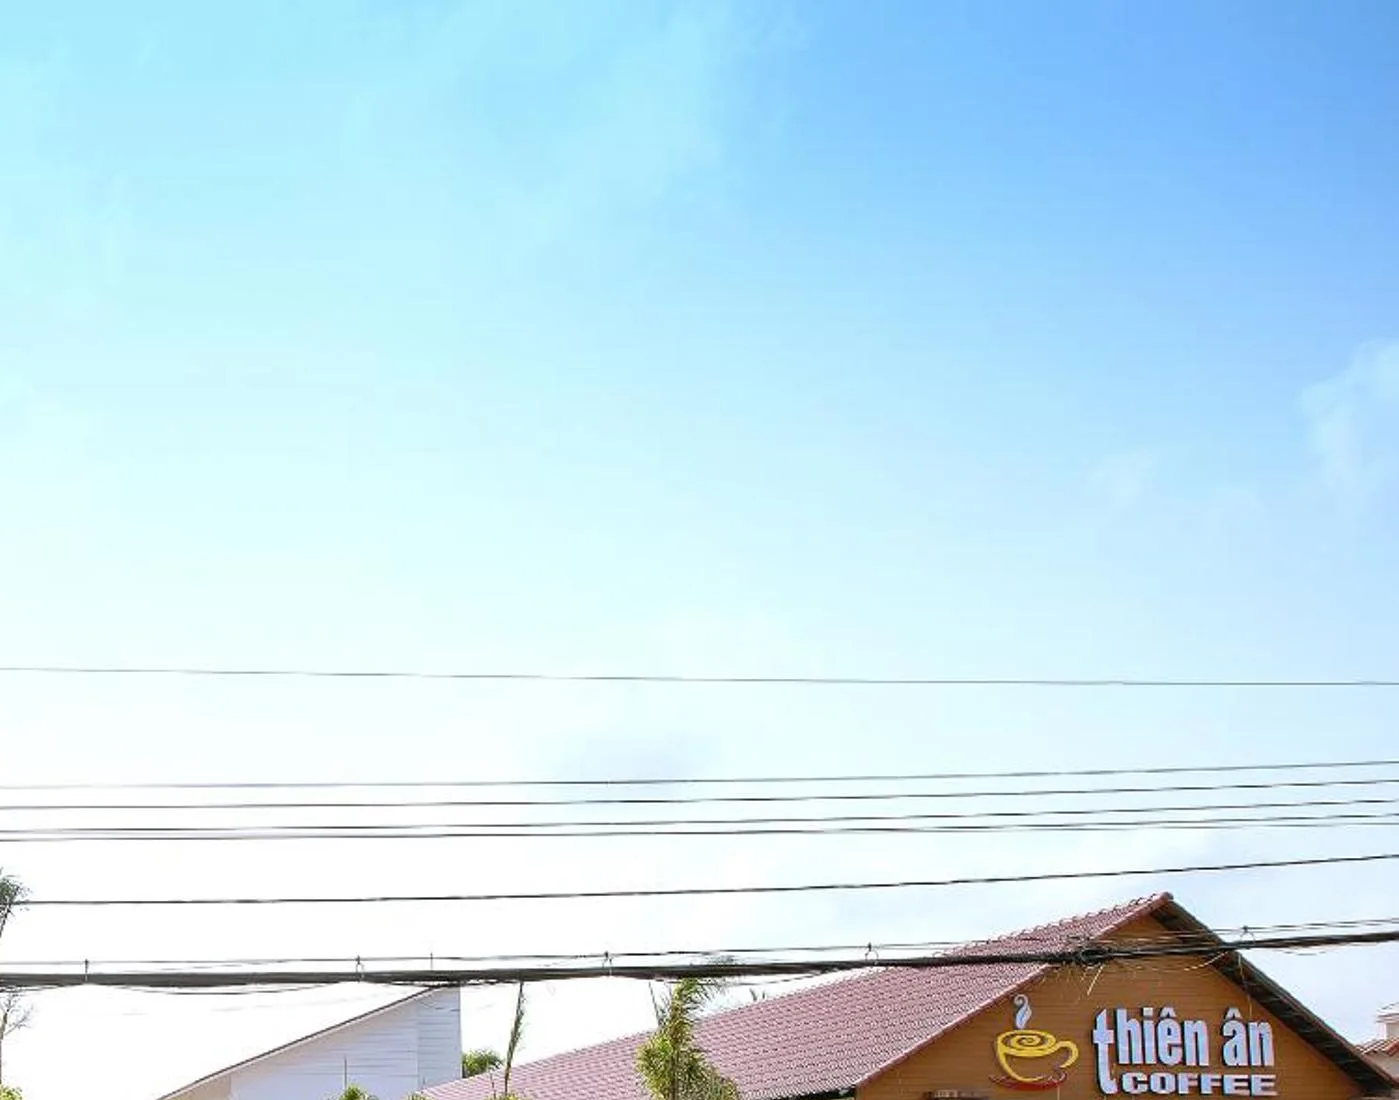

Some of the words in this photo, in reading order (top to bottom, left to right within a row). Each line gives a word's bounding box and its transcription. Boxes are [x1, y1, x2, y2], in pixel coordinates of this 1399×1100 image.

[1093, 1006, 1208, 1095] thiên
[1222, 1006, 1275, 1067] ân
[1120, 1073, 1278, 1097] COFFEE
